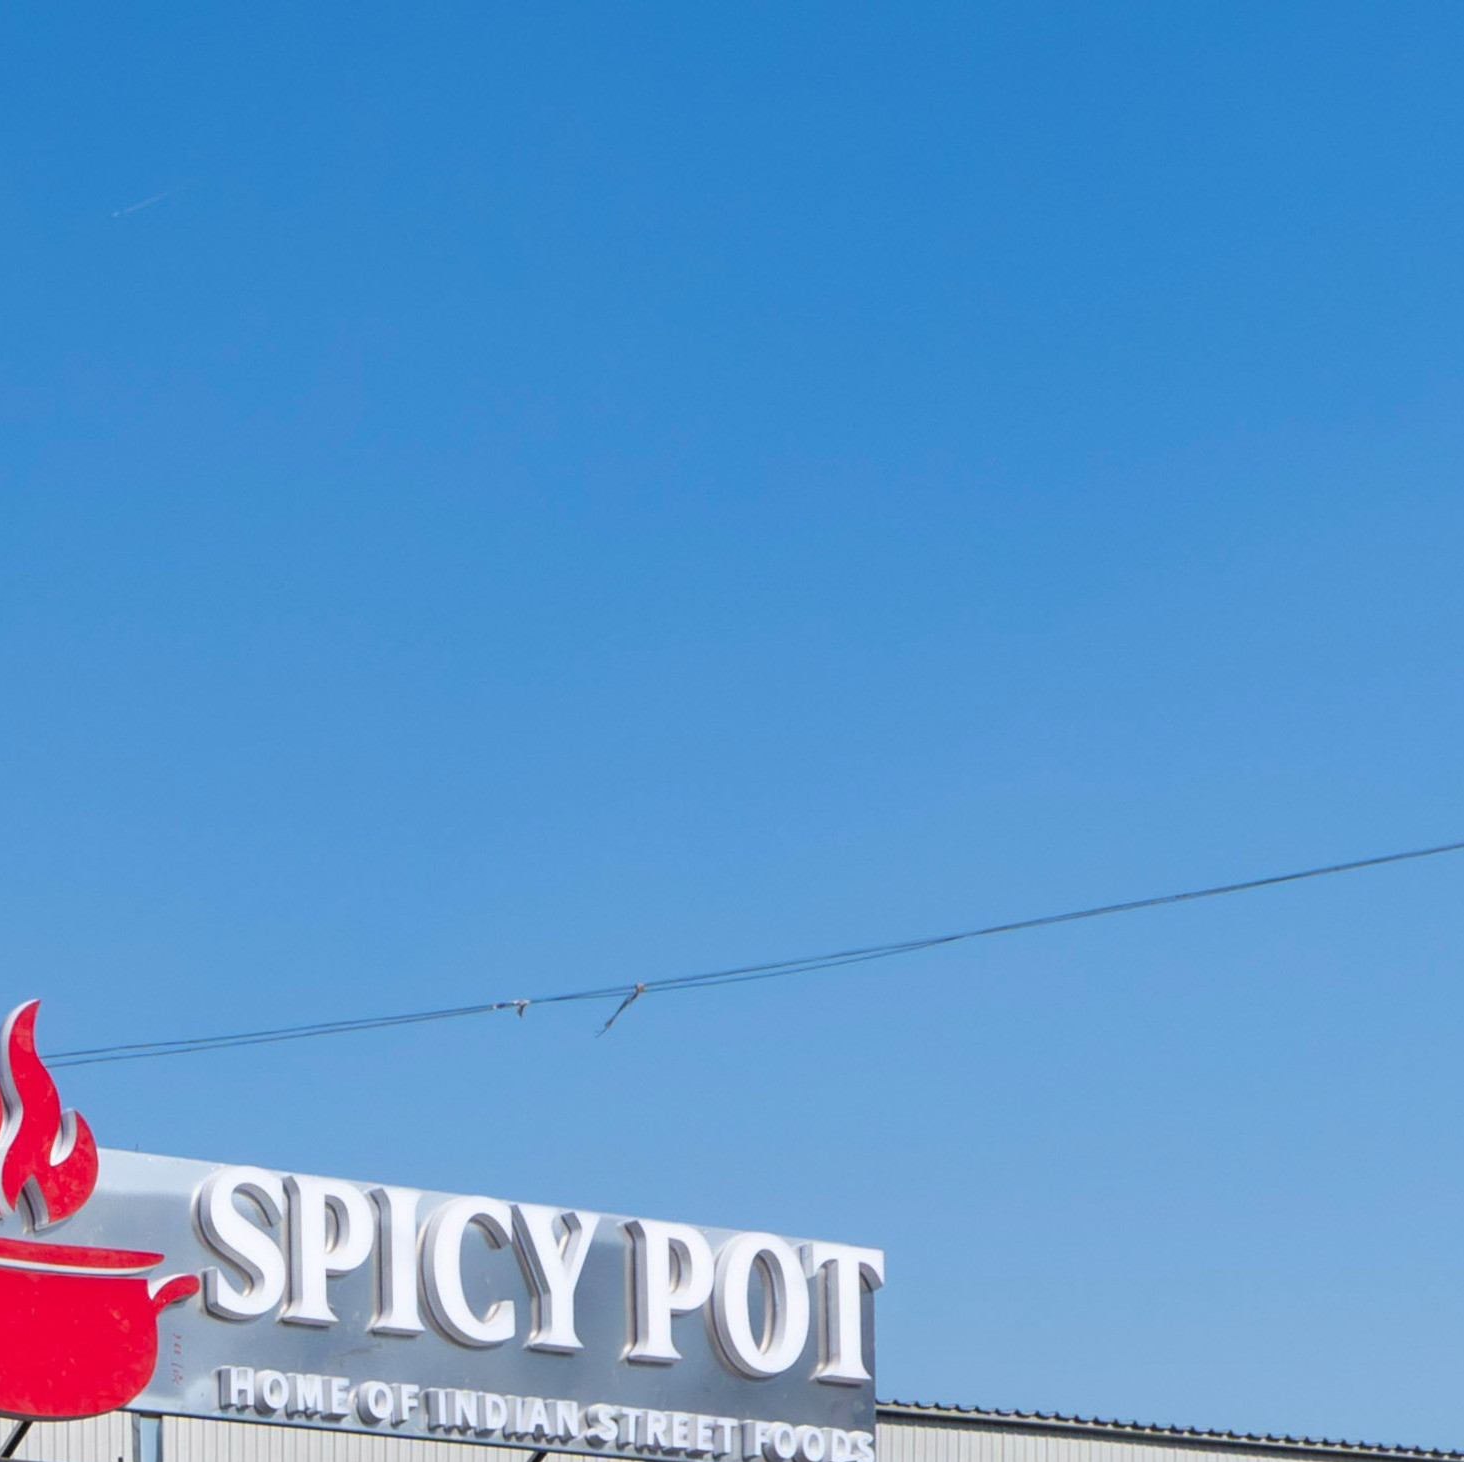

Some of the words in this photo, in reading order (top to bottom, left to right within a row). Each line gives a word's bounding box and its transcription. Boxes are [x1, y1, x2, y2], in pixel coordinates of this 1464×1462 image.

[193, 1165, 600, 1354] SPICY
[619, 1219, 885, 1386] POT
[218, 1366, 350, 1417] HOME
[356, 1379, 421, 1425] OF
[427, 1387, 580, 1444] INDIAN
[585, 1403, 738, 1459] STREET
